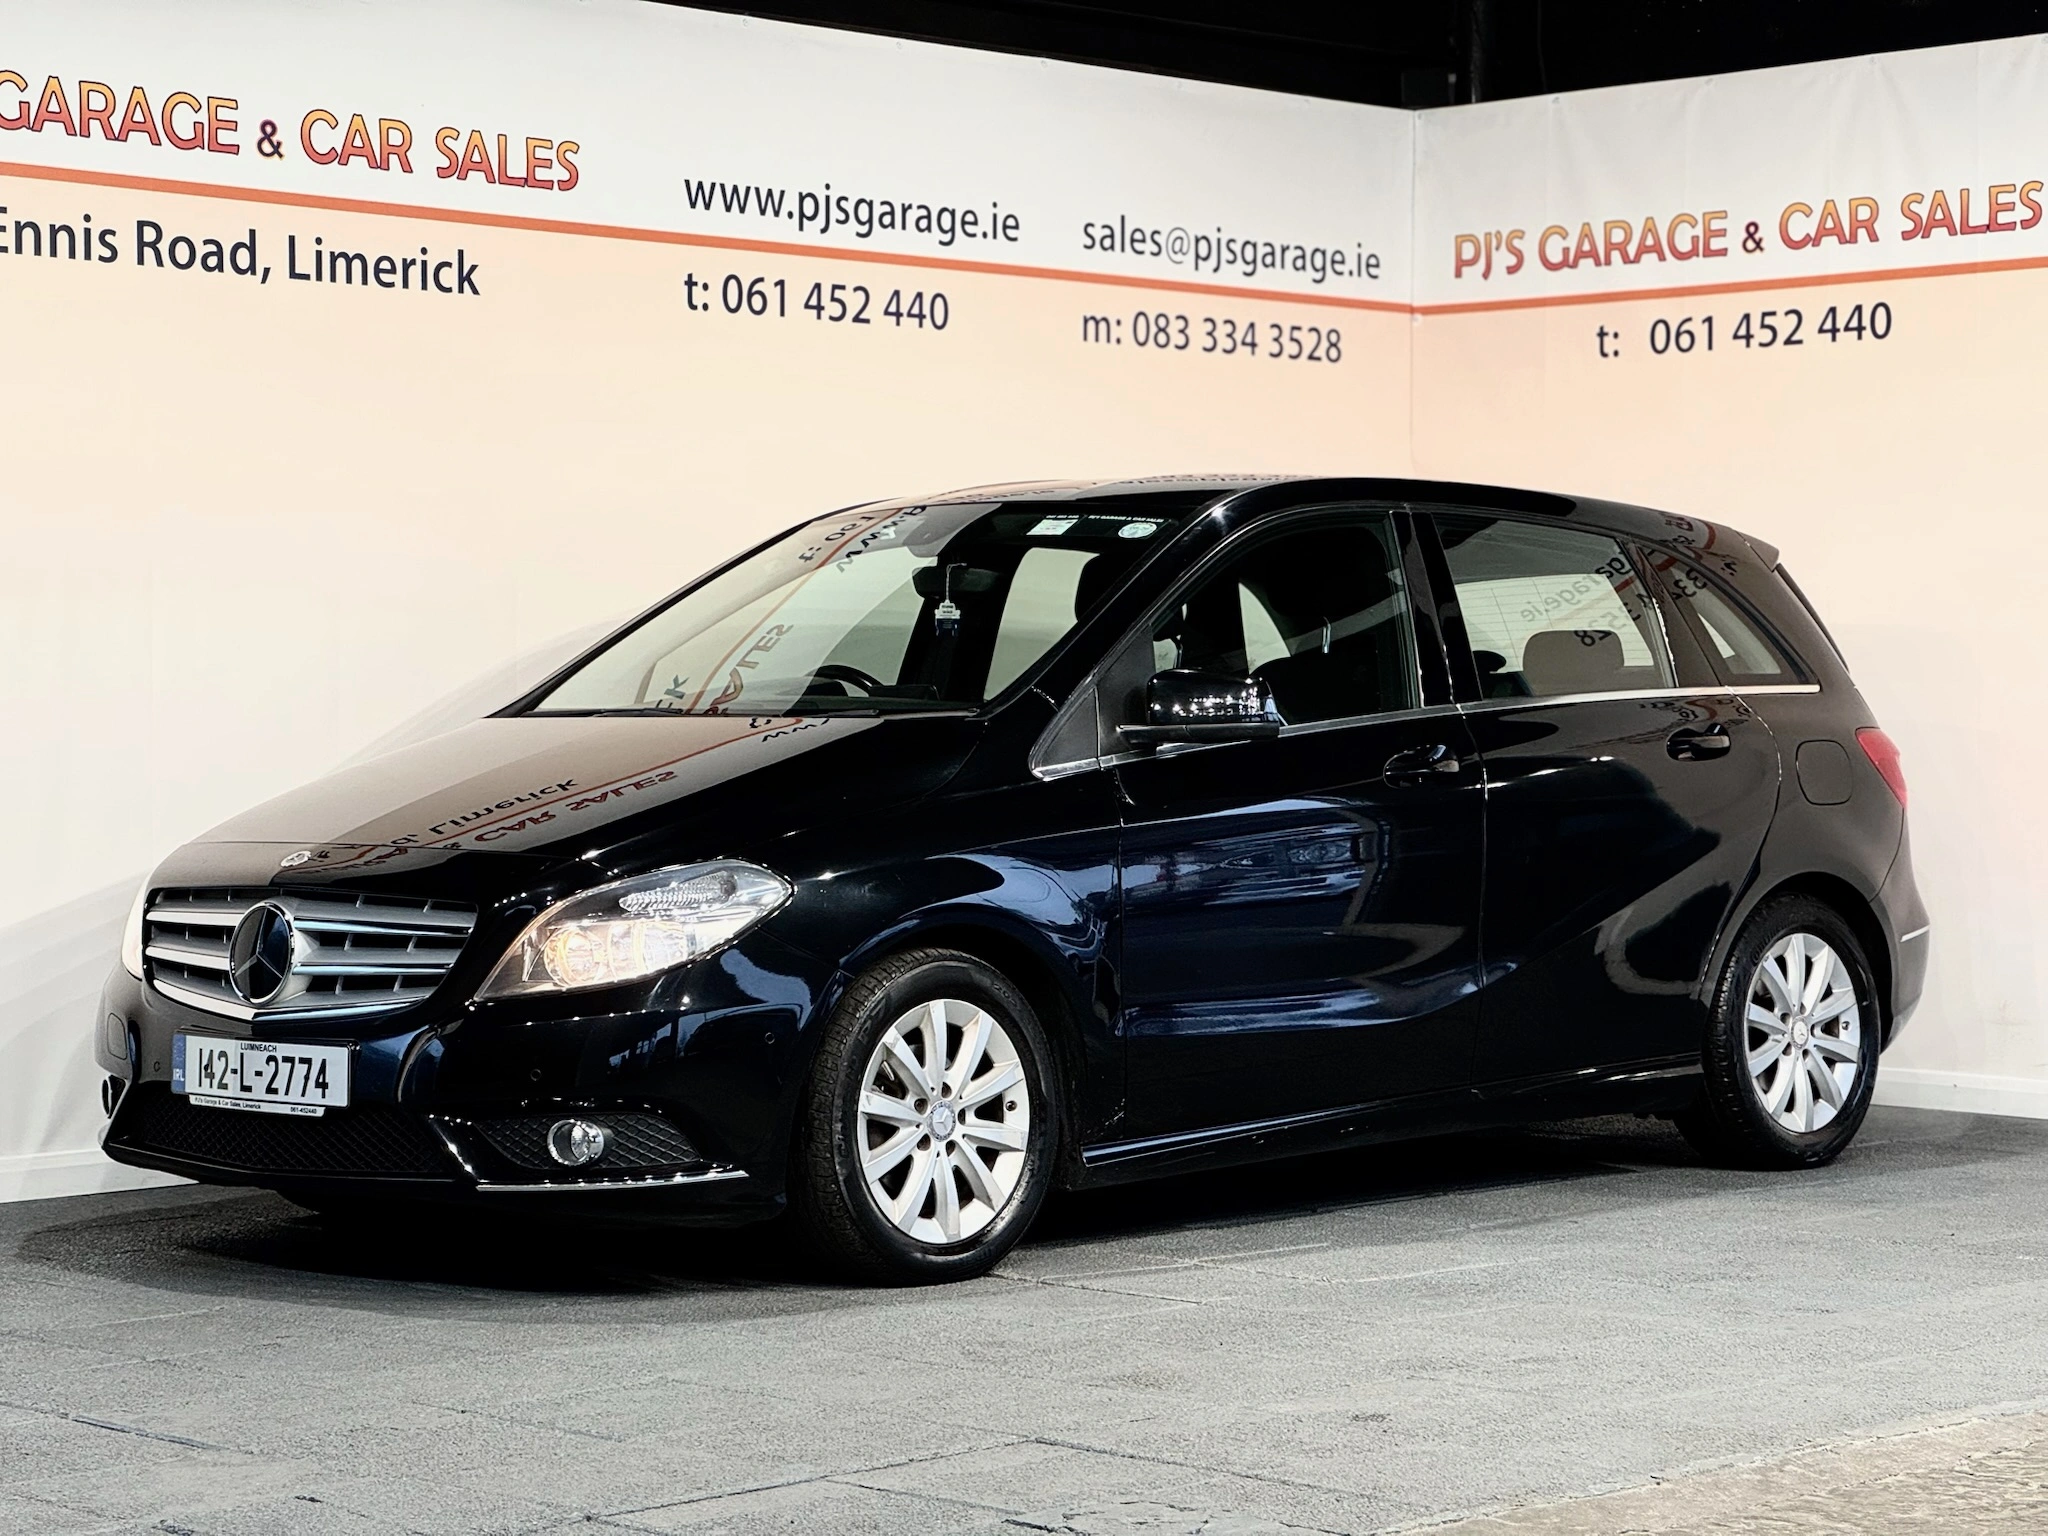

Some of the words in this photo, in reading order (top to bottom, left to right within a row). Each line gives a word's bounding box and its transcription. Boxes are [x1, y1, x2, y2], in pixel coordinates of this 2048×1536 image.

[0, 70, 240, 155] GARAGE
[256, 119, 284, 160] &
[300, 108, 413, 173] CAR
[435, 127, 580, 191] SALES
[684, 178, 1021, 245] www.pjsgarage.ie
[1454, 229, 1525, 280] PJ'S
[1538, 210, 1728, 271] GARAGE
[1741, 221, 1765, 254] &
[1779, 197, 1880, 250] CAR
[1900, 181, 2044, 242] SALES
[136, 220, 271, 284] Road,
[287, 234, 481, 296] Limerick
[1082, 215, 1381, 282] sales@pjsgarage.ie
[684, 271, 709, 312] t:
[722, 273, 788, 318] 061
[803, 281, 872, 326] 452
[884, 288, 949, 331] 440
[1596, 325, 1620, 359] t:
[1650, 315, 1715, 355] 061
[1732, 308, 1804, 349] 452
[1817, 302, 1893, 343] 440
[1082, 311, 1122, 345] m:
[1132, 310, 1190, 351] 083
[1201, 317, 1258, 357] 334
[1268, 322, 1342, 363] 3528
[198, 1047, 329, 1099] 142-L-2774
[240, 1042, 277, 1053] LUIMNEACH
